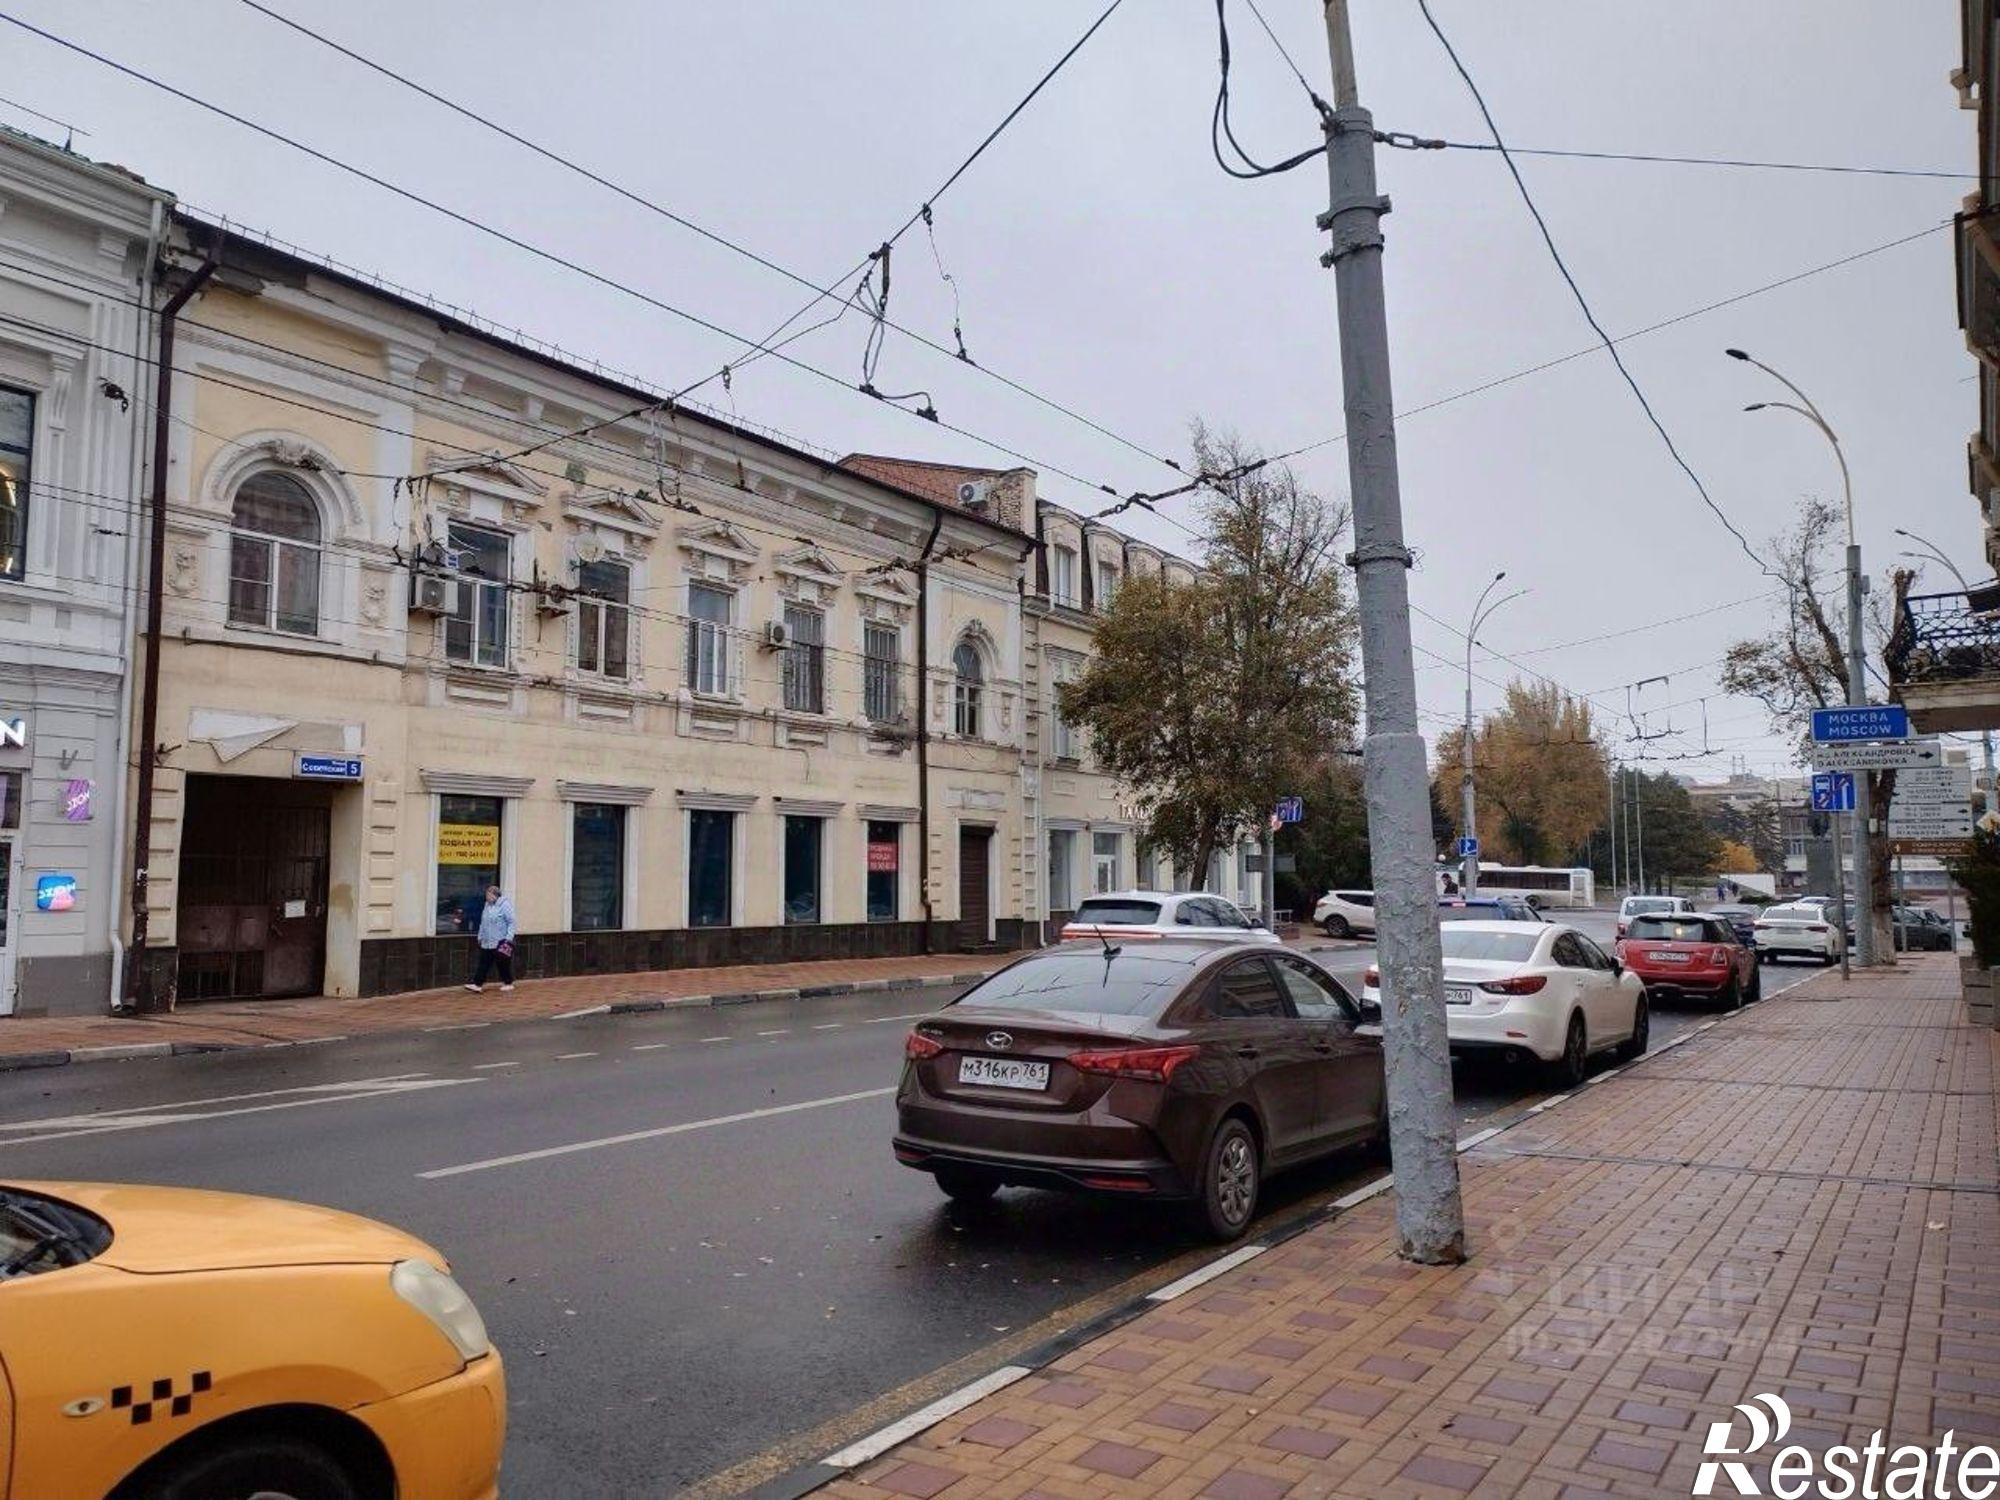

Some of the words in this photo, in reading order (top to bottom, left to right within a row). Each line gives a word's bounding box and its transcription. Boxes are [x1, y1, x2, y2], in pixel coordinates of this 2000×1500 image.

[1828, 711, 1888, 724] МОСКВА
[1828, 724, 1892, 736] MOSCOW
[350, 763, 358, 774] 5
